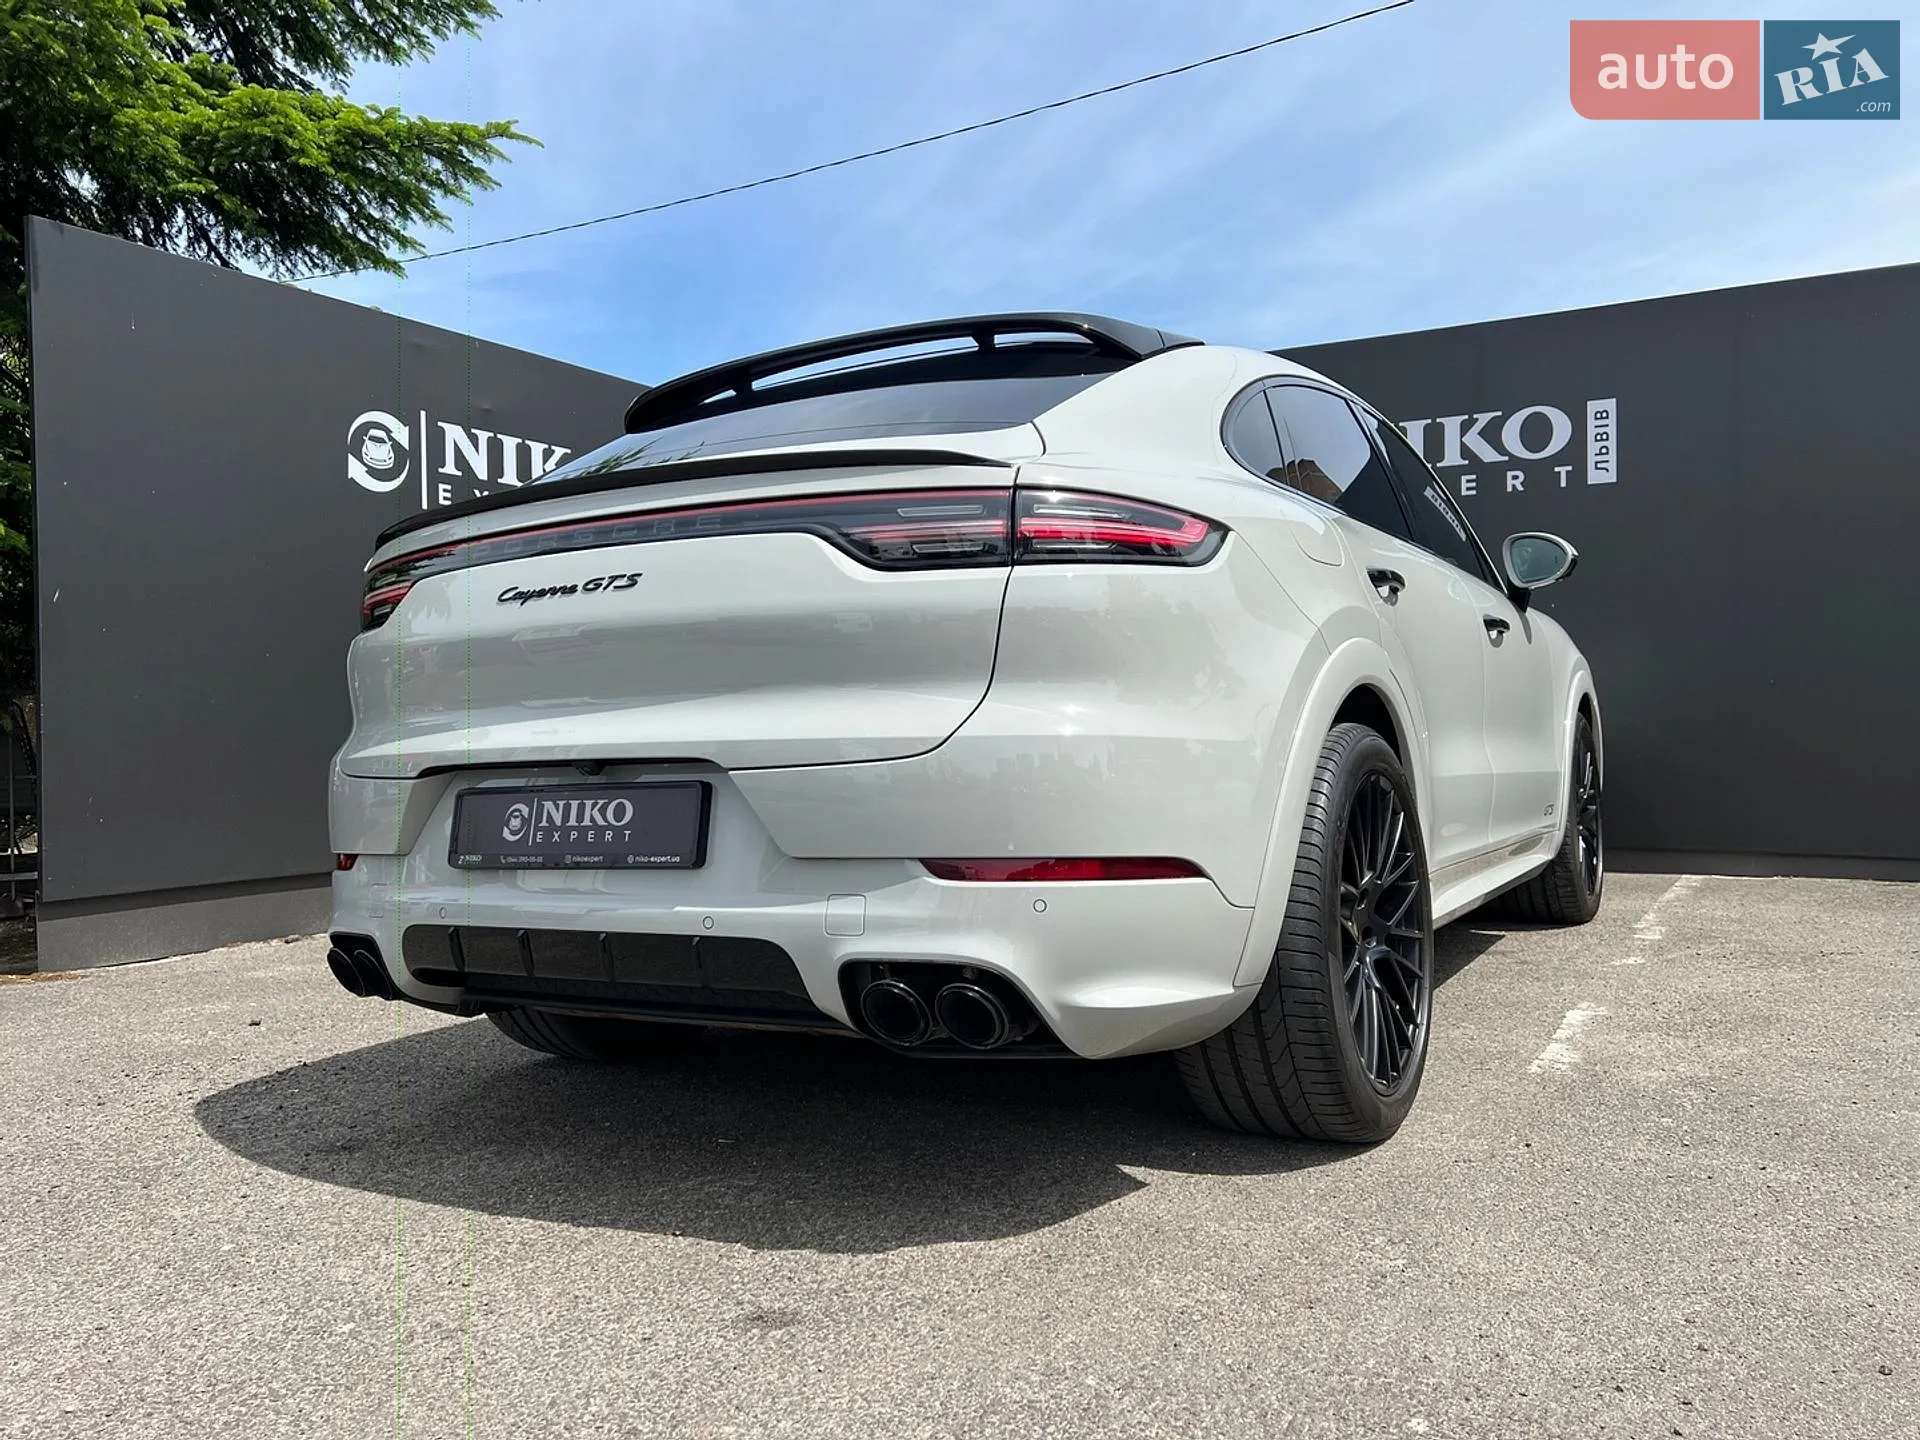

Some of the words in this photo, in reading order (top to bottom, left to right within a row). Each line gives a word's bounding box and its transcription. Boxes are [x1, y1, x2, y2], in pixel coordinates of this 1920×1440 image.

[1399, 405, 1573, 467] IKO
[1594, 408, 1610, 473] ЛЬВІВ
[437, 421, 572, 487] NIK
[1461, 465, 1573, 496] ERT
[497, 586, 579, 607] Cayenne
[582, 572, 644, 592] GTS
[538, 798, 634, 827] NIKO
[536, 830, 632, 843] EXPERT
